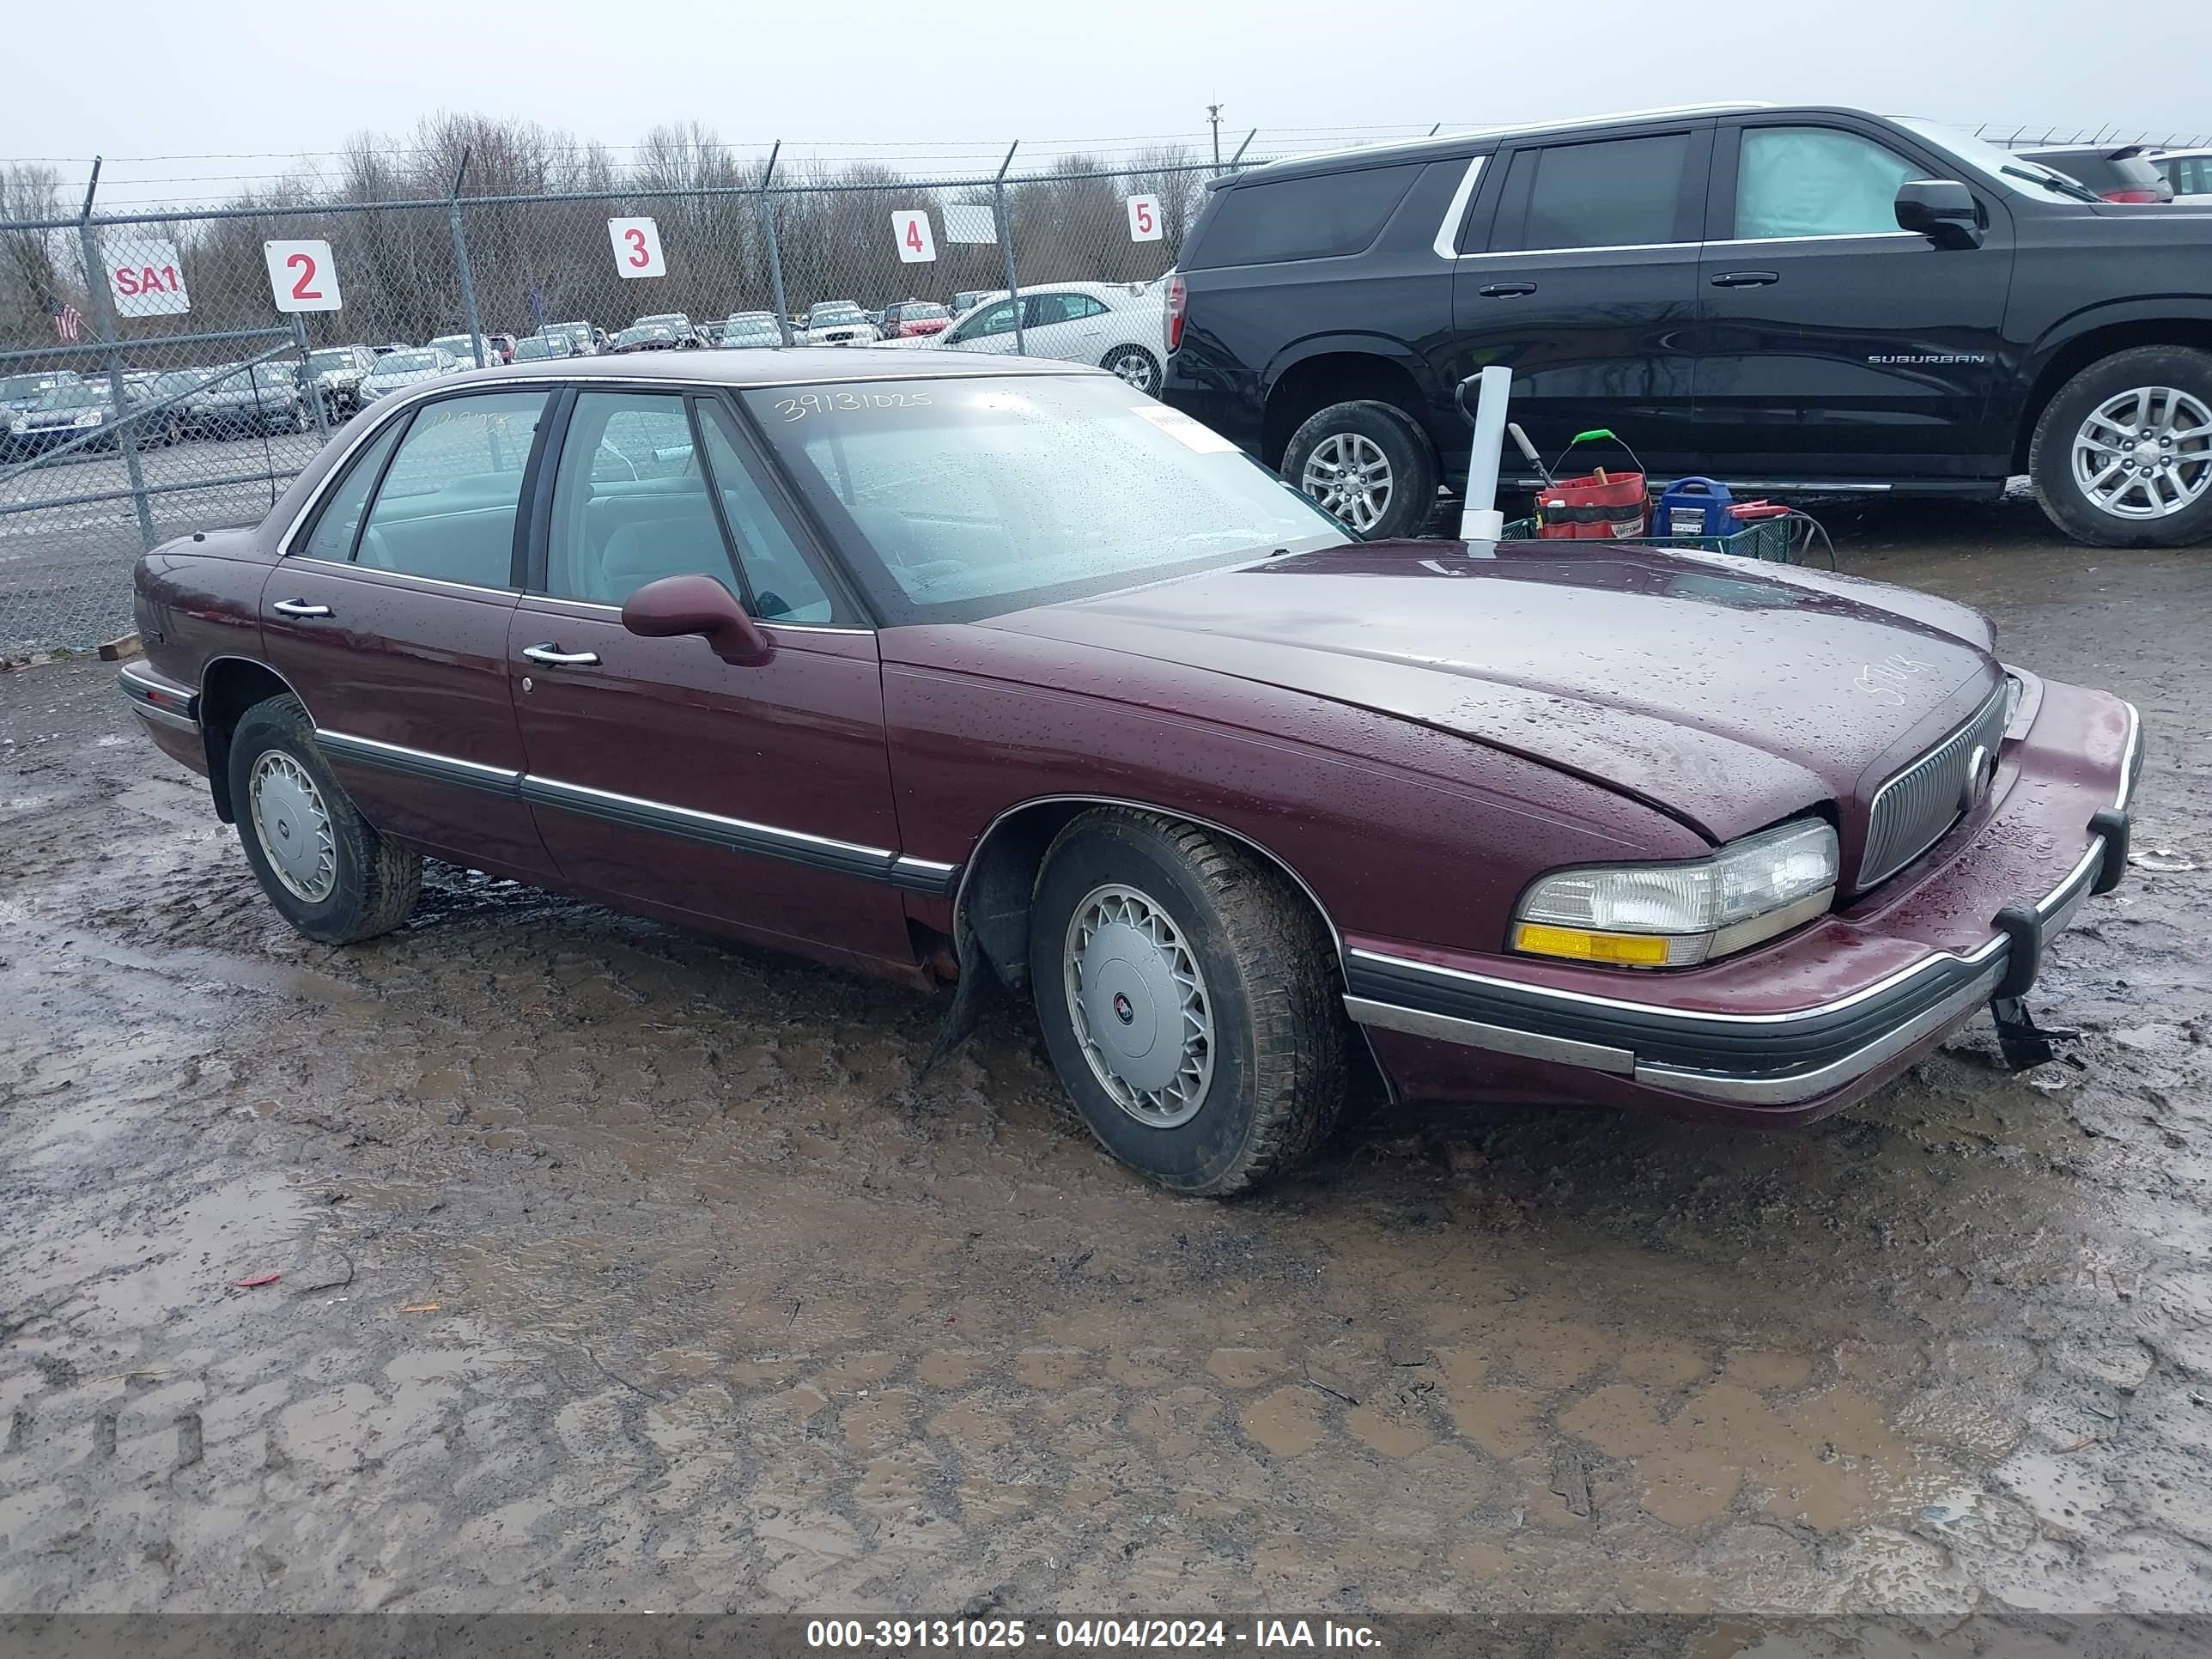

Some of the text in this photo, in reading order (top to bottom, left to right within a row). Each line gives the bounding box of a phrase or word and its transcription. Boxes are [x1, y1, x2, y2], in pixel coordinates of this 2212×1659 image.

[1136, 203, 1152, 234] 5
[624, 228, 651, 269] 3
[906, 220, 924, 253] 4
[115, 265, 180, 296] SA1
[286, 254, 323, 301] 2
[1868, 356, 1985, 364] SUBURBAN
[775, 392, 933, 422] 39131025
